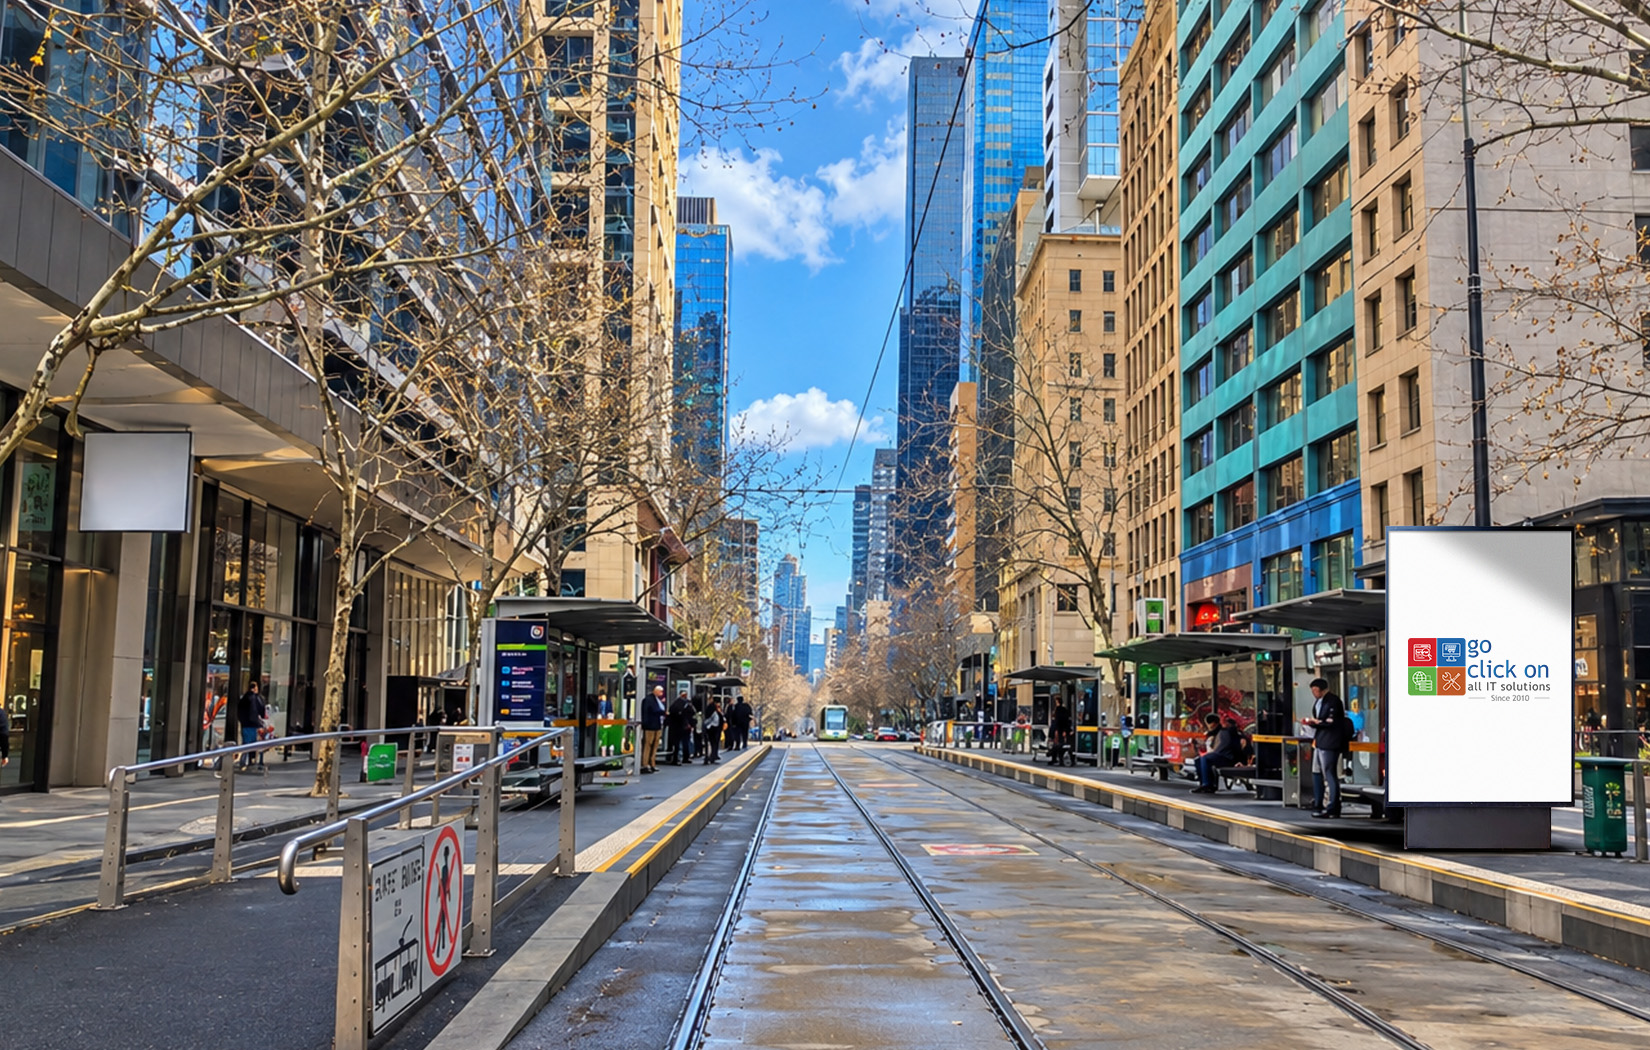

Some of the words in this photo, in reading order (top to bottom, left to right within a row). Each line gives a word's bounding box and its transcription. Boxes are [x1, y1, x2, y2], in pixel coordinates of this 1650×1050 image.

[1467, 639, 1492, 658] go
[1467, 659, 1518, 679] click
[1523, 664, 1549, 679] on
[1467, 681, 1482, 692] all
[1486, 681, 1498, 692] IT
[1500, 681, 1551, 692] solutions
[1490, 694, 1511, 702] Since
[1512, 694, 1530, 702] 2010
